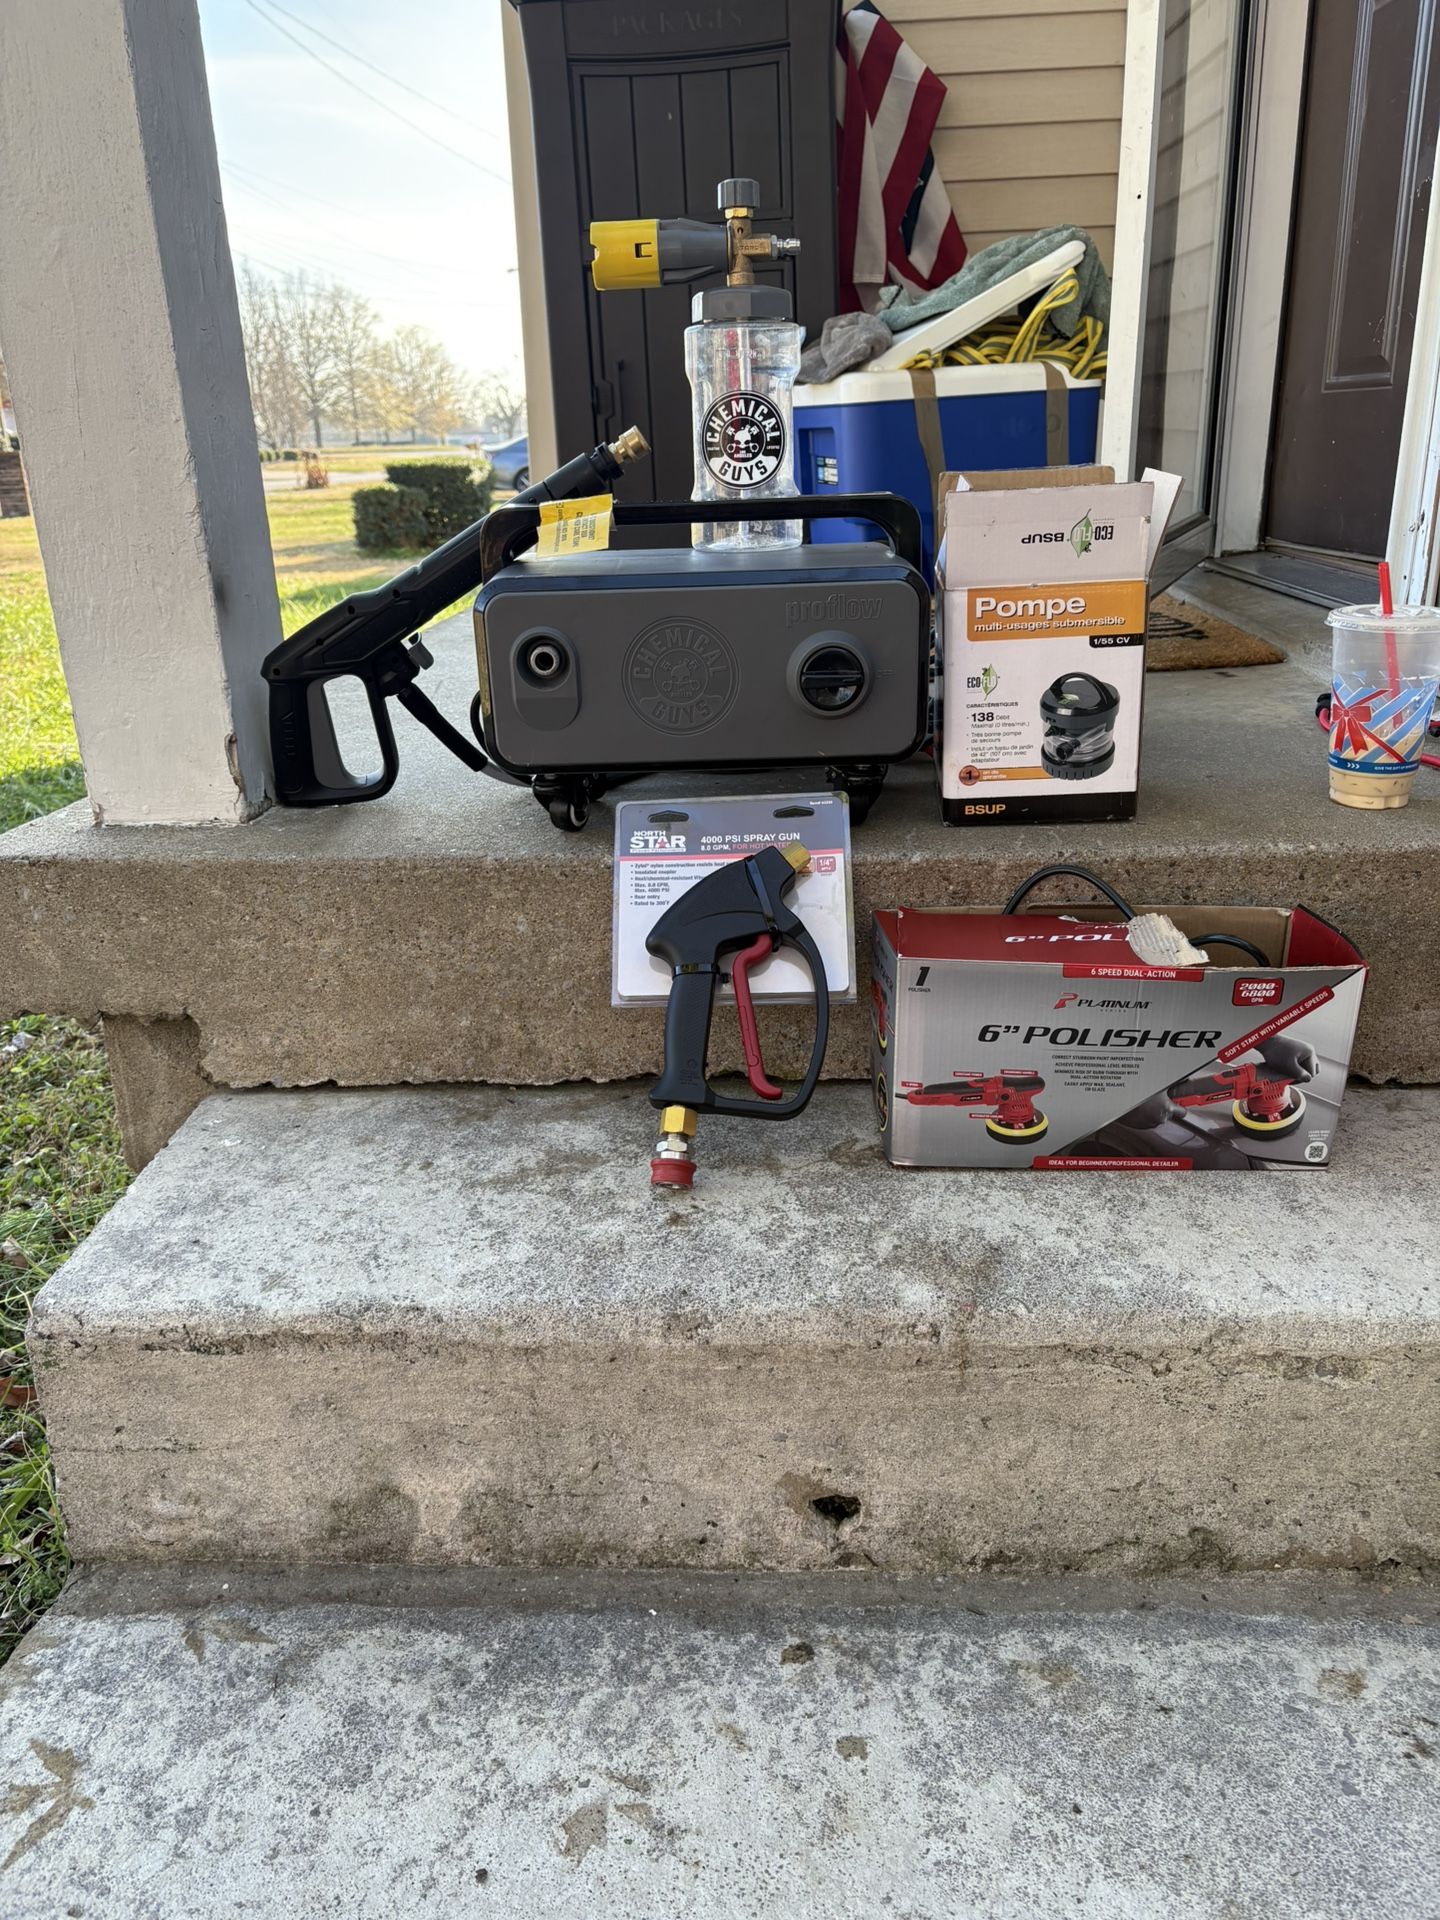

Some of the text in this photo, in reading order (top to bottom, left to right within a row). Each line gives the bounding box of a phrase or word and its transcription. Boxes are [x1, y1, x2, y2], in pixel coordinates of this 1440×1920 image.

[612, 8, 743, 36] PACKAGES
[706, 399, 780, 442] CHEMICAL
[719, 460, 768, 481] GUYS
[1021, 532, 1065, 544] BSUP
[785, 593, 884, 627] proflow
[975, 597, 1086, 620] Pompe
[974, 616, 1126, 632] multi-usages submersible
[1093, 636, 1131, 646] 1/55 CV
[632, 626, 729, 681] CHEMICAL
[651, 700, 714, 727] GUYS
[971, 712, 995, 723] 138
[966, 770, 973, 780] 1
[965, 804, 1006, 815] BSUP
[630, 835, 687, 849] STAR
[700, 832, 801, 844] 4000 PSI SPRAY GUN
[915, 966, 931, 987] 1
[1091, 968, 1177, 979] 6 SPEED DUAL-ACTION
[1240, 982, 1279, 990] 2000-
[1077, 999, 1150, 1010] PLATINUM
[1225, 991, 1329, 1058] SOFT START WITH VARIABLE SPEEDS
[1023, 1027, 1223, 1048] POLISHER
